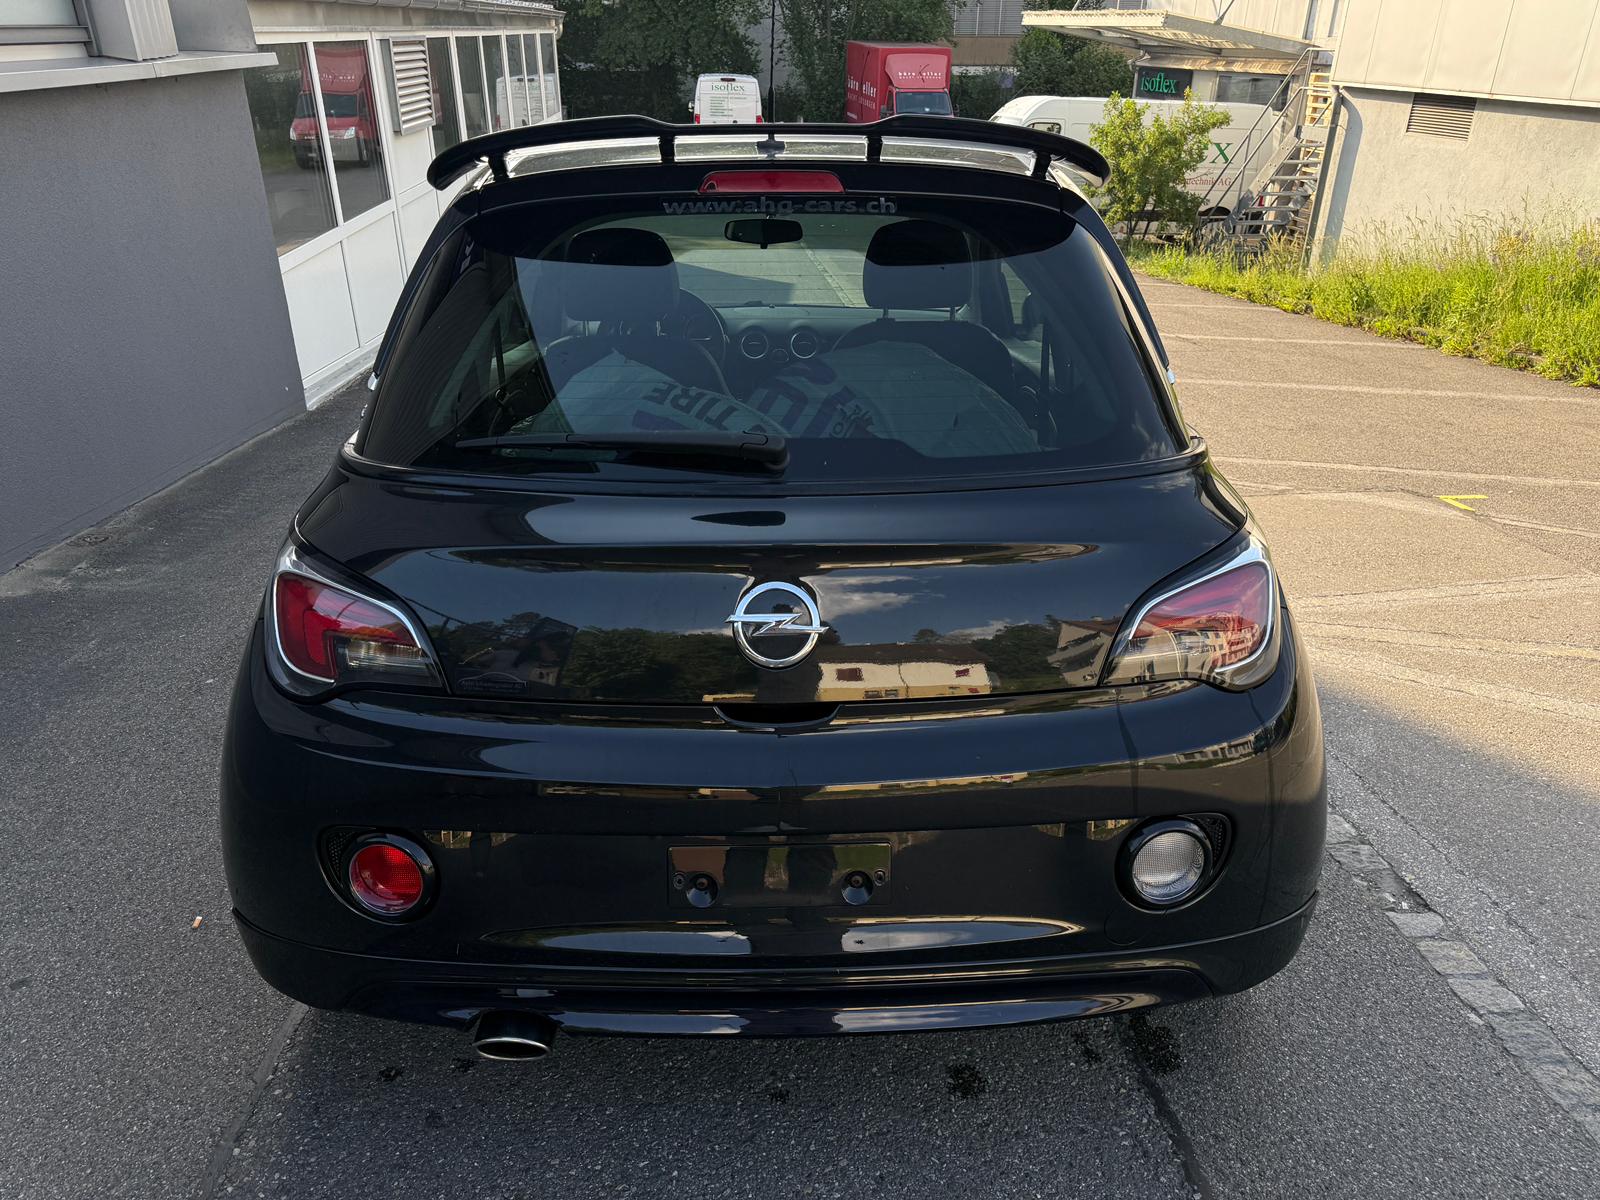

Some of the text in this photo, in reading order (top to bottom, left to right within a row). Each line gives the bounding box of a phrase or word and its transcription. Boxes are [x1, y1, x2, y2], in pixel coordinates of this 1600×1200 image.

[711, 82, 745, 92] isoflex
[1140, 72, 1177, 94] isoflex
[1218, 177, 1232, 186] AG
[662, 197, 898, 214] www.ahg-cars.ch
[641, 381, 739, 431] TIRE
